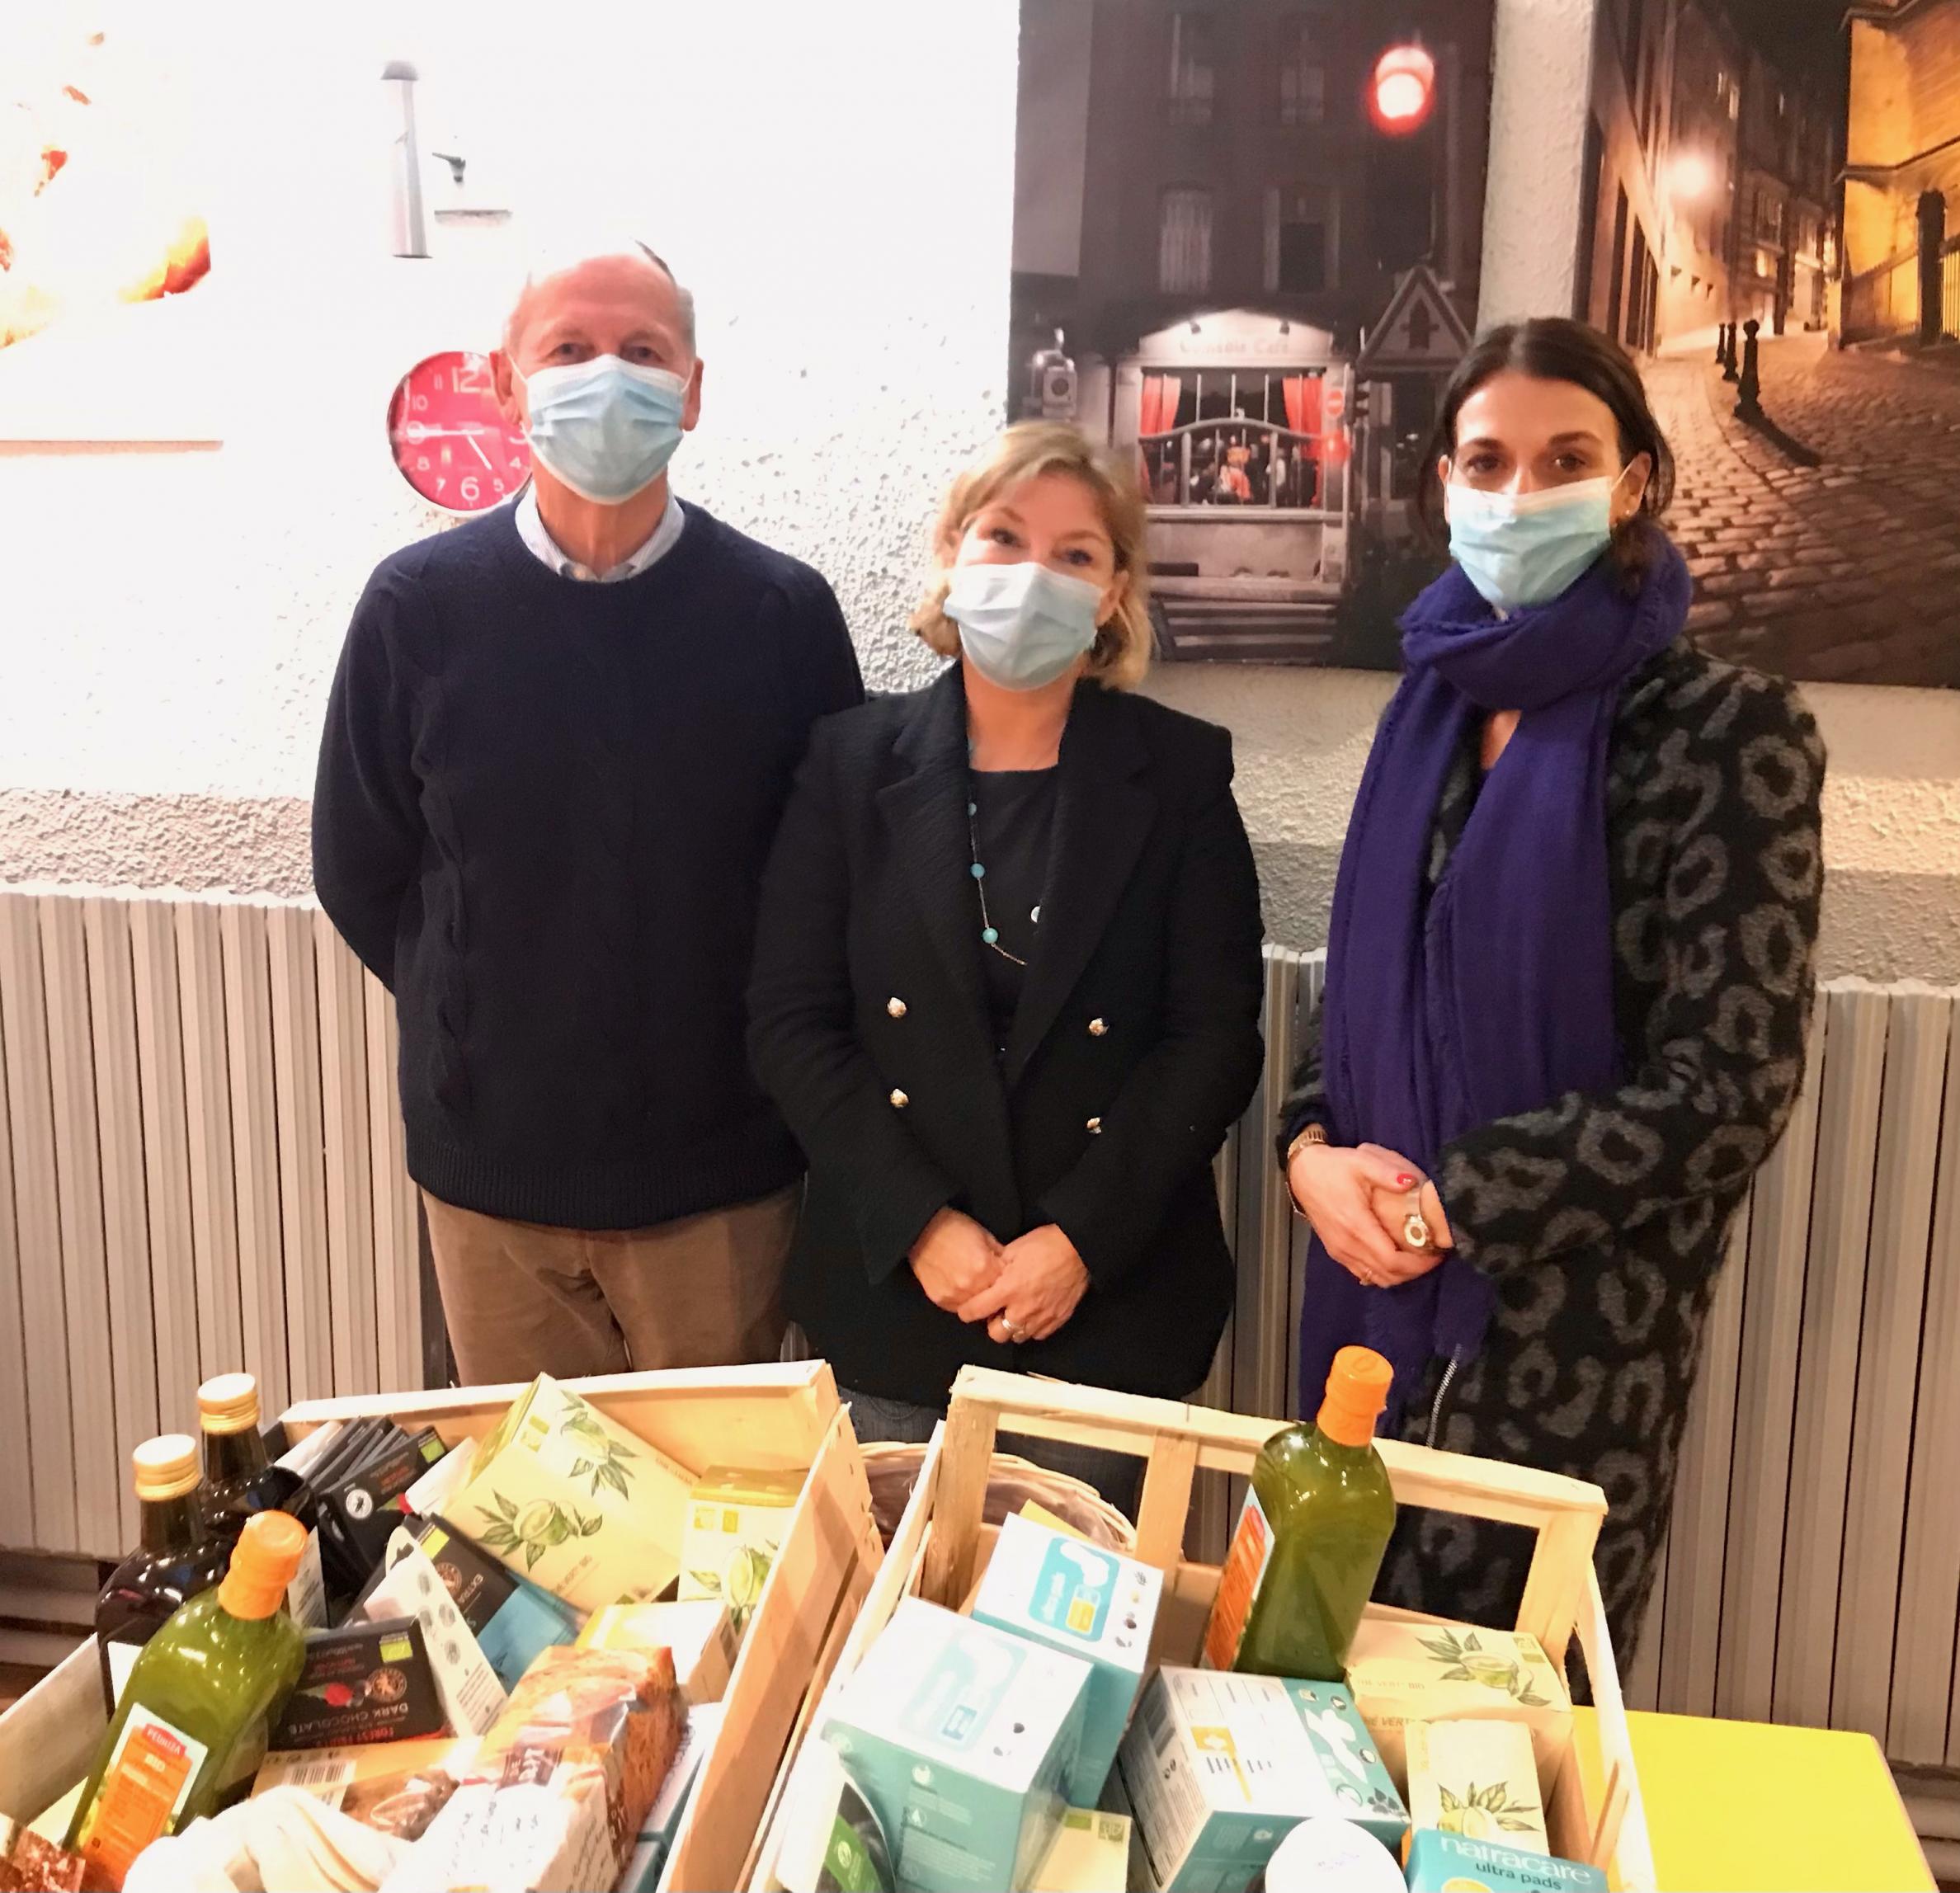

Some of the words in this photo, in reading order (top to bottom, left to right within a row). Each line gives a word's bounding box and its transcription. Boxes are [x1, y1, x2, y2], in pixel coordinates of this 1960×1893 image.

[433, 374, 443, 390] 11
[451, 367, 481, 393] 12
[412, 396, 428, 411] 10
[417, 456, 430, 470] 8
[509, 455, 522, 469] 4
[460, 476, 479, 502] 6
[492, 478, 504, 492] 5
[374, 1702, 408, 1718] DARK
[290, 1711, 369, 1734] CHOCOLATE
[356, 1727, 394, 1744] FOREST
[1440, 1836, 1591, 1885] natracare
[1476, 1862, 1515, 1879] ultra
[1521, 1872, 1562, 1891] pads
